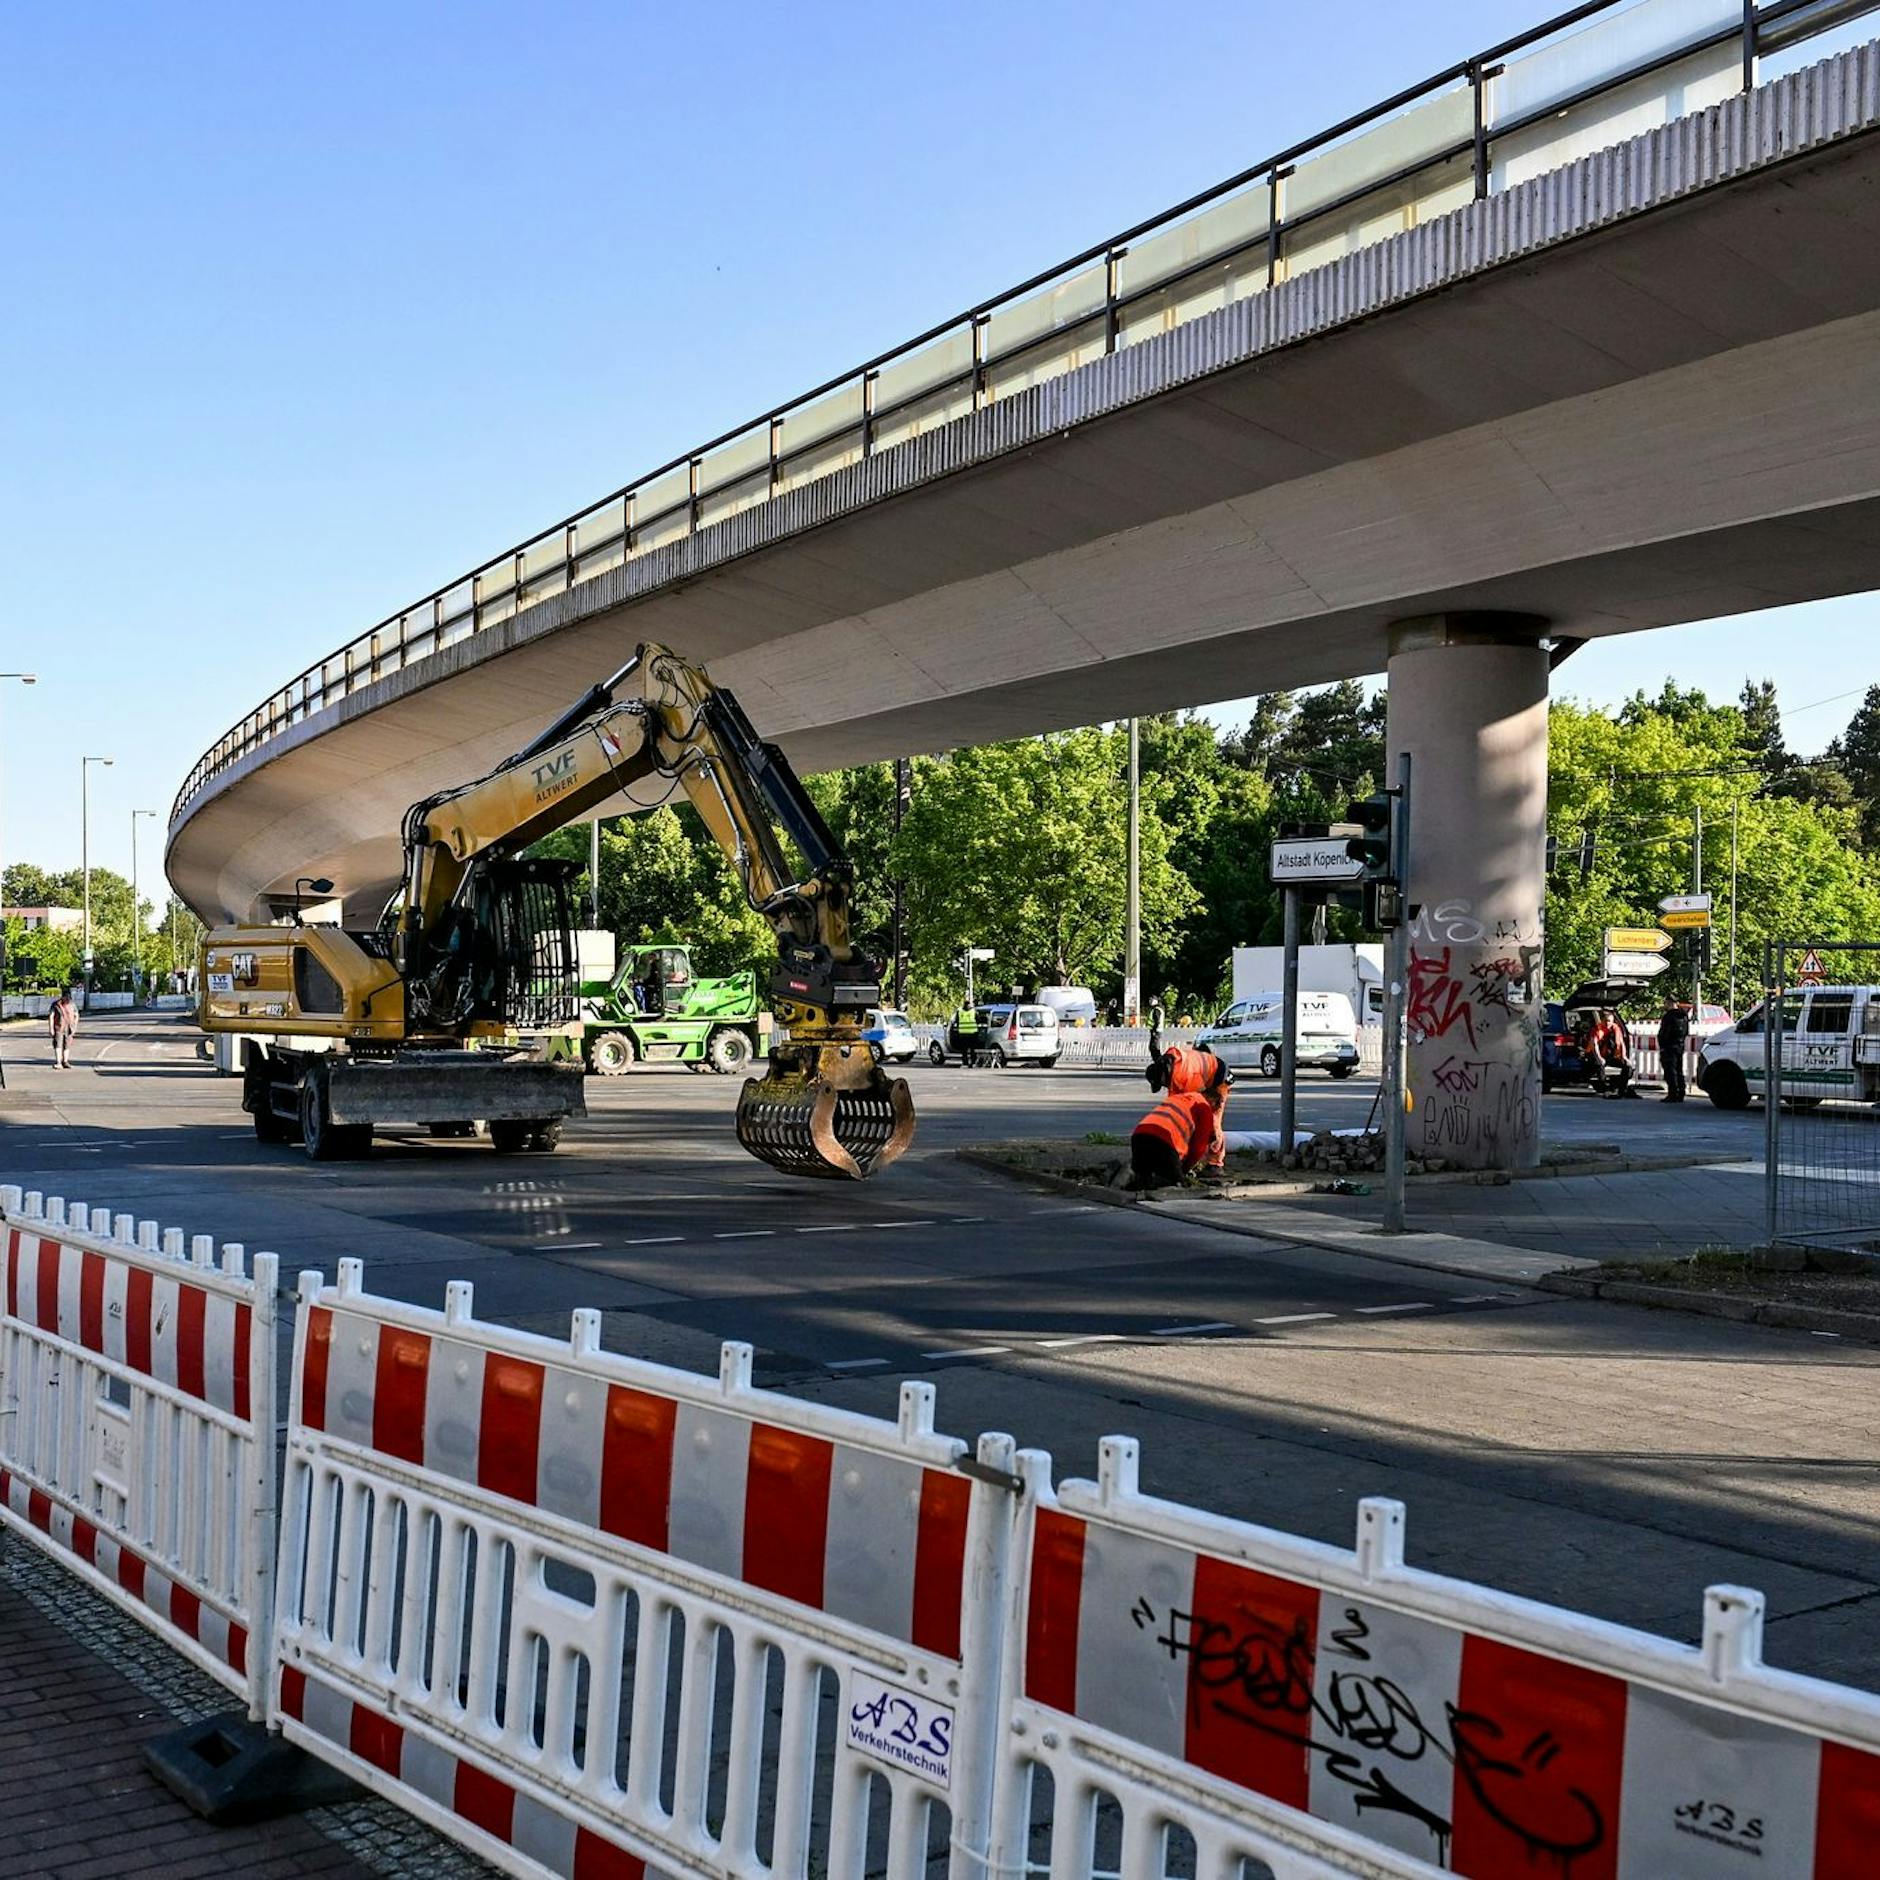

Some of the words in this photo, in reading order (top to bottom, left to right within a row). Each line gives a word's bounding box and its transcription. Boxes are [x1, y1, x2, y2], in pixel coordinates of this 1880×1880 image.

[531, 748, 576, 785] TVF
[536, 772, 579, 803] ALTWERT
[1277, 852, 1311, 868] Altstadt
[232, 953, 253, 980] CAT
[1249, 1002, 1271, 1012] TVF
[1301, 1002, 1329, 1010] TVF
[1806, 1046, 1840, 1055] TVF
[851, 1692, 951, 1757] ABS
[850, 1724, 948, 1779] Verkehrstechnik
[1675, 1800, 1763, 1839] ABS
